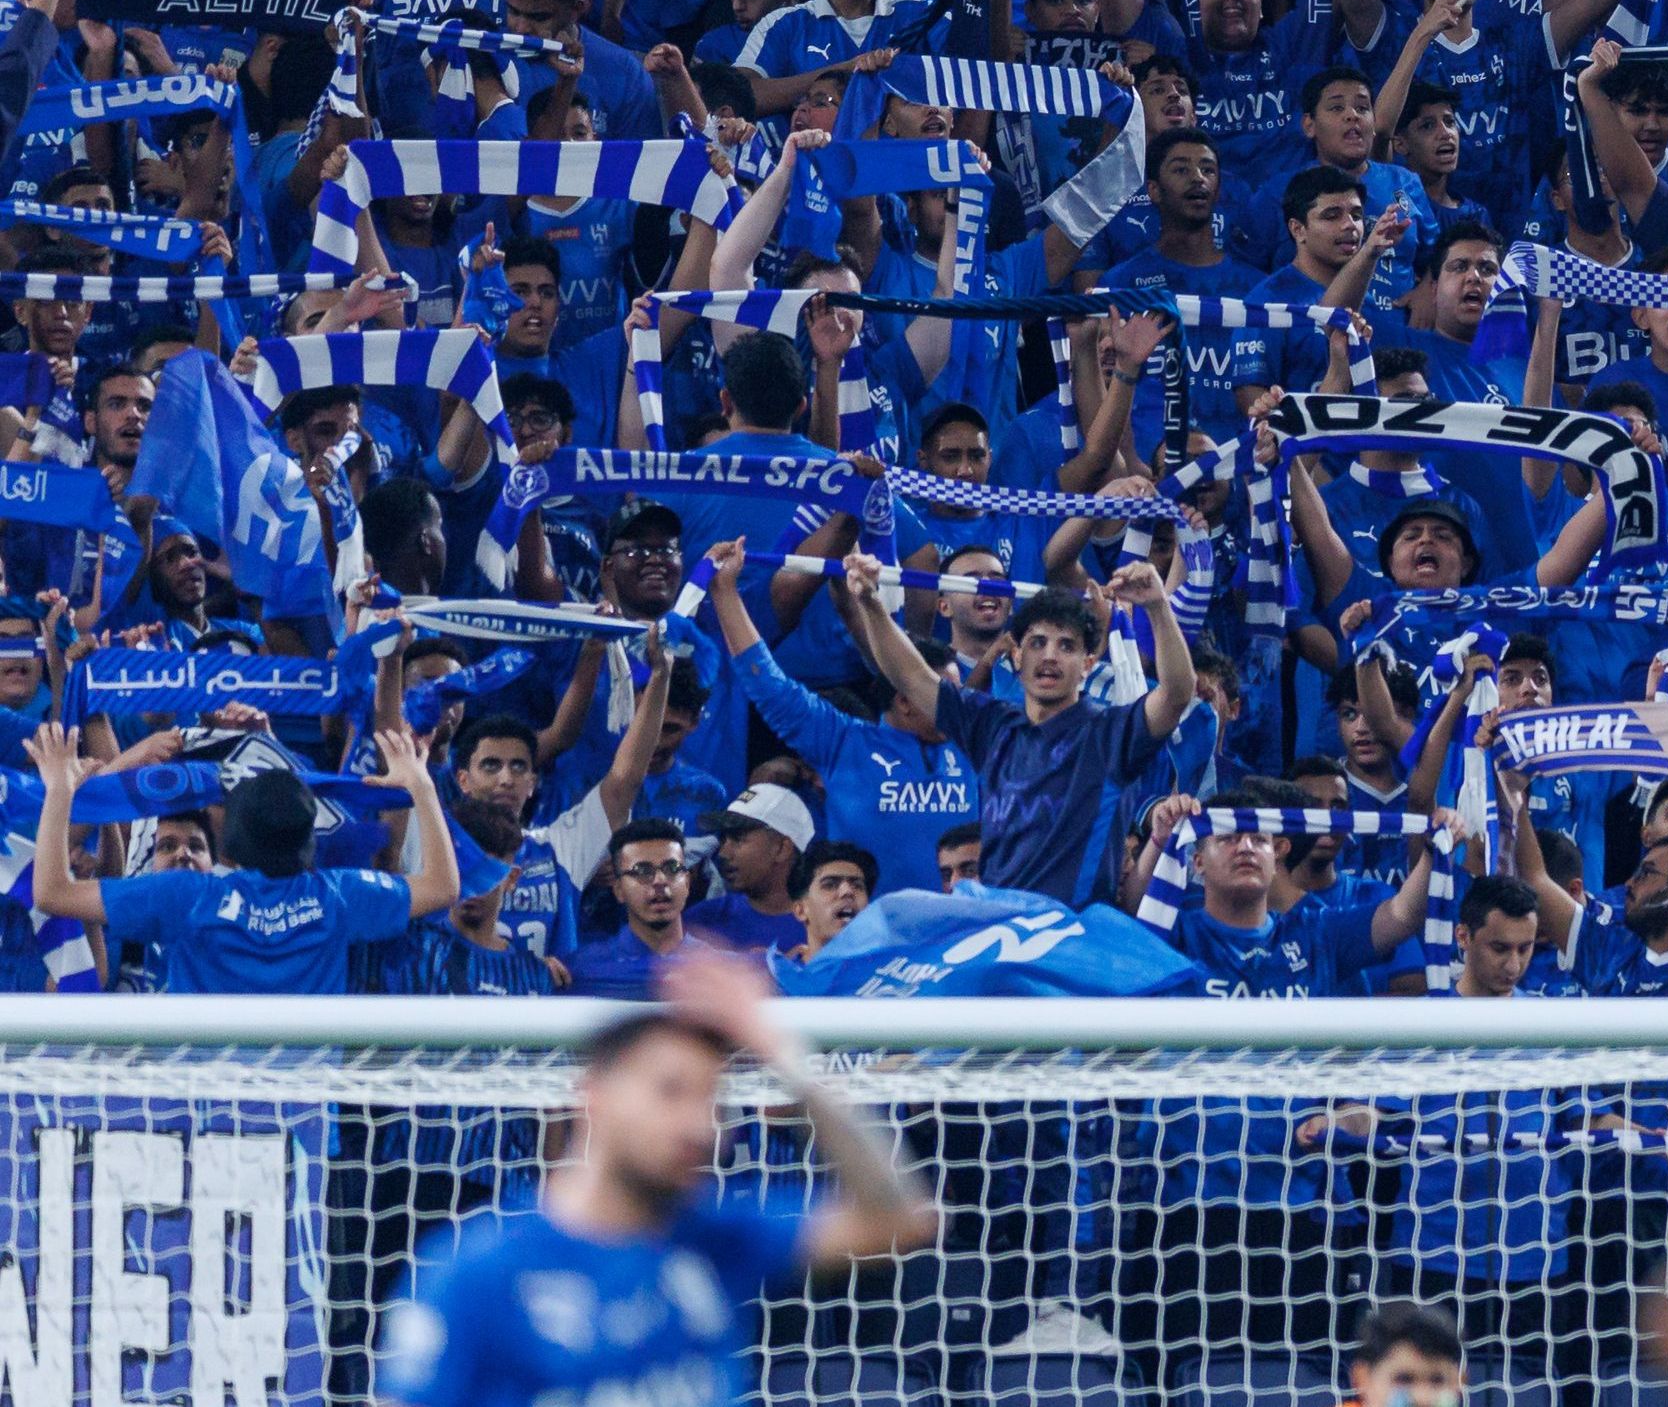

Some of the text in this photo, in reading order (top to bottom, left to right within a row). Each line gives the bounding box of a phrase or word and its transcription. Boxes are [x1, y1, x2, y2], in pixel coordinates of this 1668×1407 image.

[1197, 91, 1285, 123] SAVVY
[574, 447, 753, 485] ALHILAL
[206, 657, 341, 698] زعيم
[879, 780, 968, 805] SAVVY
